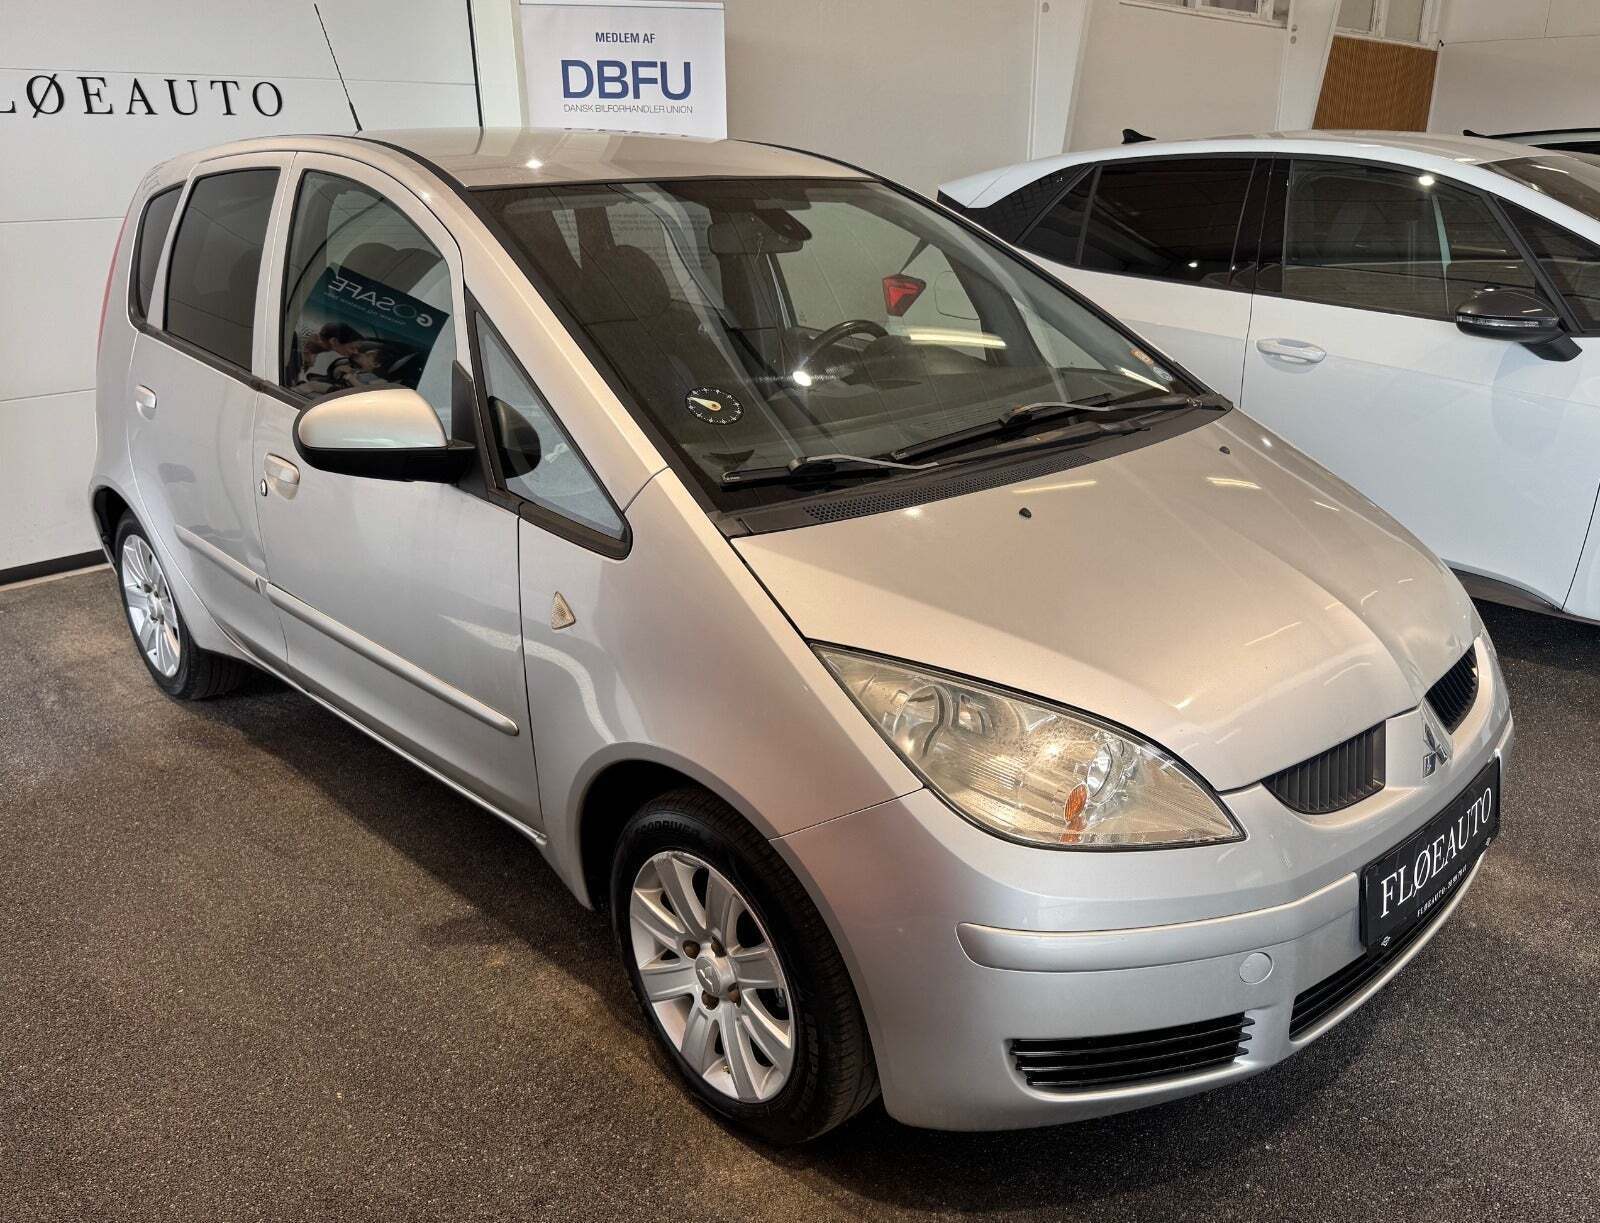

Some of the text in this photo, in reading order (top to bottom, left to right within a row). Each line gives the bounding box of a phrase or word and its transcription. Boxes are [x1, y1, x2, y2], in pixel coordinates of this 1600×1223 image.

[595, 32, 656, 44] MEDLEM AF
[561, 59, 692, 101] DBFU
[563, 104, 694, 114] DANSK BILFORHANDLER UNION
[1380, 787, 1492, 919] FLØEAUTO
